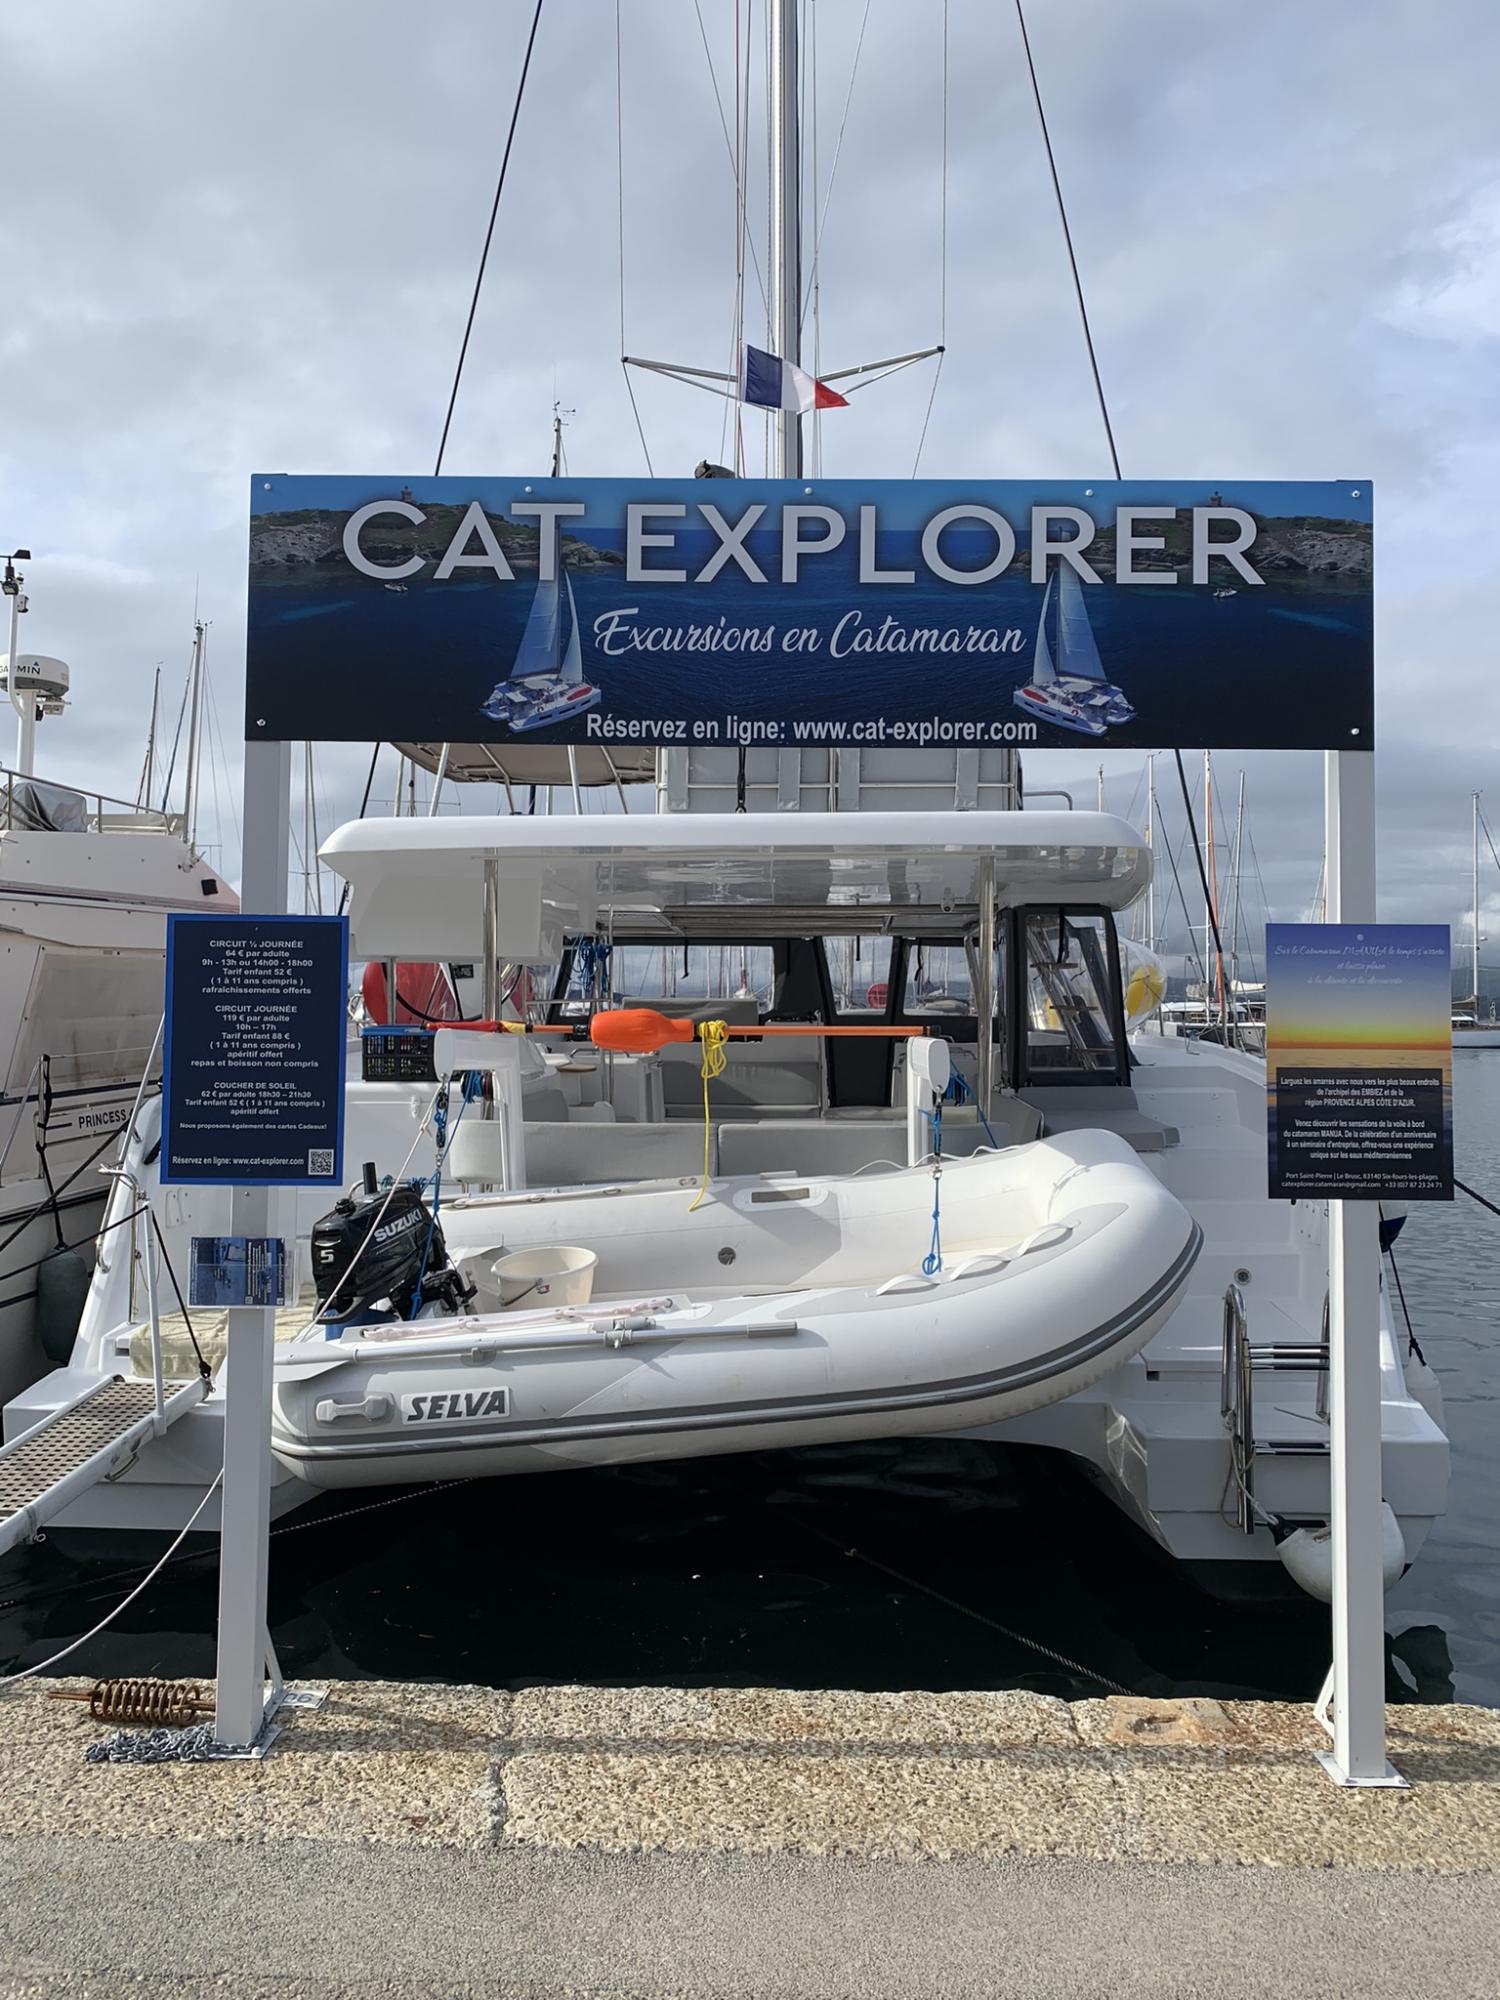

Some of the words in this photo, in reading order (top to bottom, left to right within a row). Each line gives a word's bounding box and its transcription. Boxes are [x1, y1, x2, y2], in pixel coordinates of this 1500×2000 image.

[342, 500, 585, 582] CAT
[626, 503, 1266, 585] EXPLORER
[593, 607, 772, 656] Excursions
[781, 623, 824, 653] en
[829, 610, 1027, 659] Catamaran
[0, 665, 41, 675] GAMIN
[586, 713, 687, 739] Réservez
[693, 720, 719, 739] en
[726, 714, 786, 745] ligne:
[793, 717, 1037, 746] www.cat-explorer.com
[1281, 1077, 1303, 1086] Larguez
[1386, 1078, 1398, 1086] plus
[1325, 1088, 1350, 1097] l'archipel
[1305, 1099, 1323, 1107] région
[1376, 1097, 1392, 1106] CÔTE
[78, 1108, 127, 1129] PRINCESS
[1327, 1141, 1360, 1149] d'entreprise,
[213, 1157, 231, 1166] ligne:
[374, 1208, 423, 1242] SUZUKI
[320, 1249, 335, 1264] 5
[407, 1389, 506, 1422] SELVA
